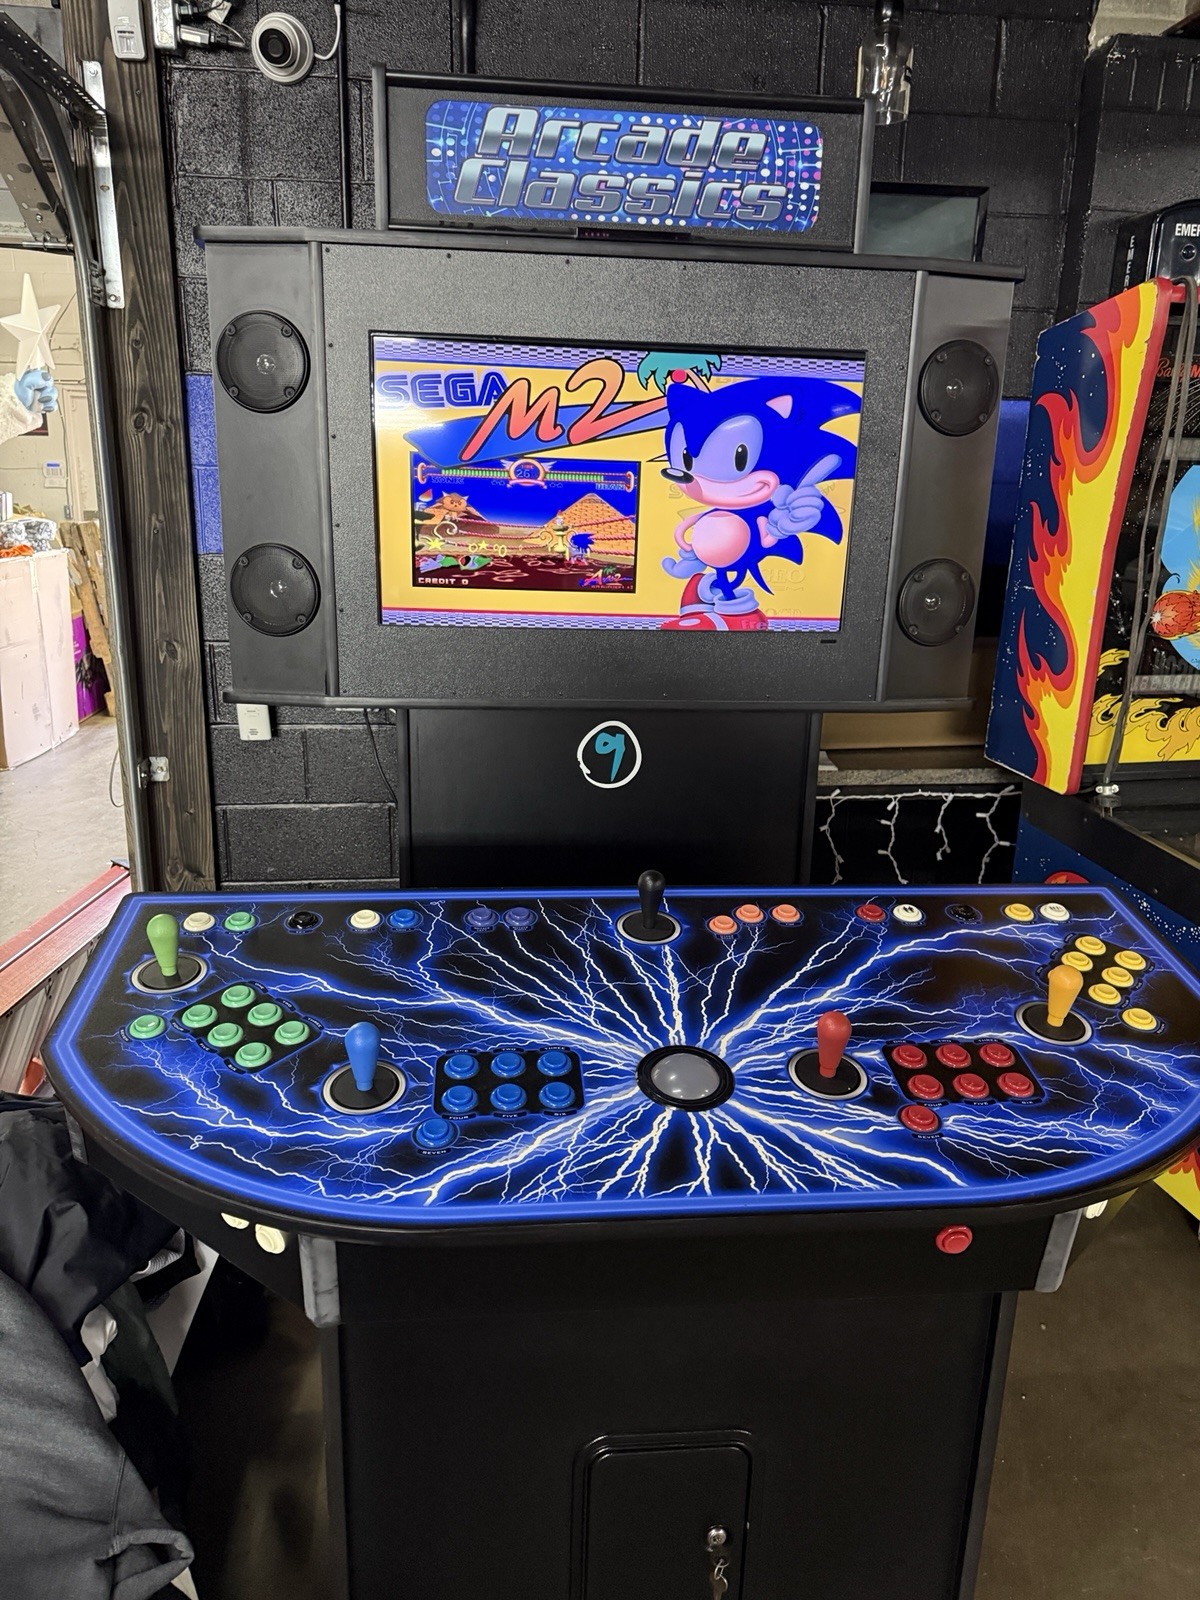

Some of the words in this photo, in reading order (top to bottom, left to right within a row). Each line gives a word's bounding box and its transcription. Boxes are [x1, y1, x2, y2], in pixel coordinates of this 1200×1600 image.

[476, 105, 769, 171] Arcade
[454, 157, 788, 222] Classics
[375, 370, 508, 408] SEGA
[516, 469, 531, 478] 26
[418, 577, 457, 585] CREDIT
[594, 732, 626, 782] 9
